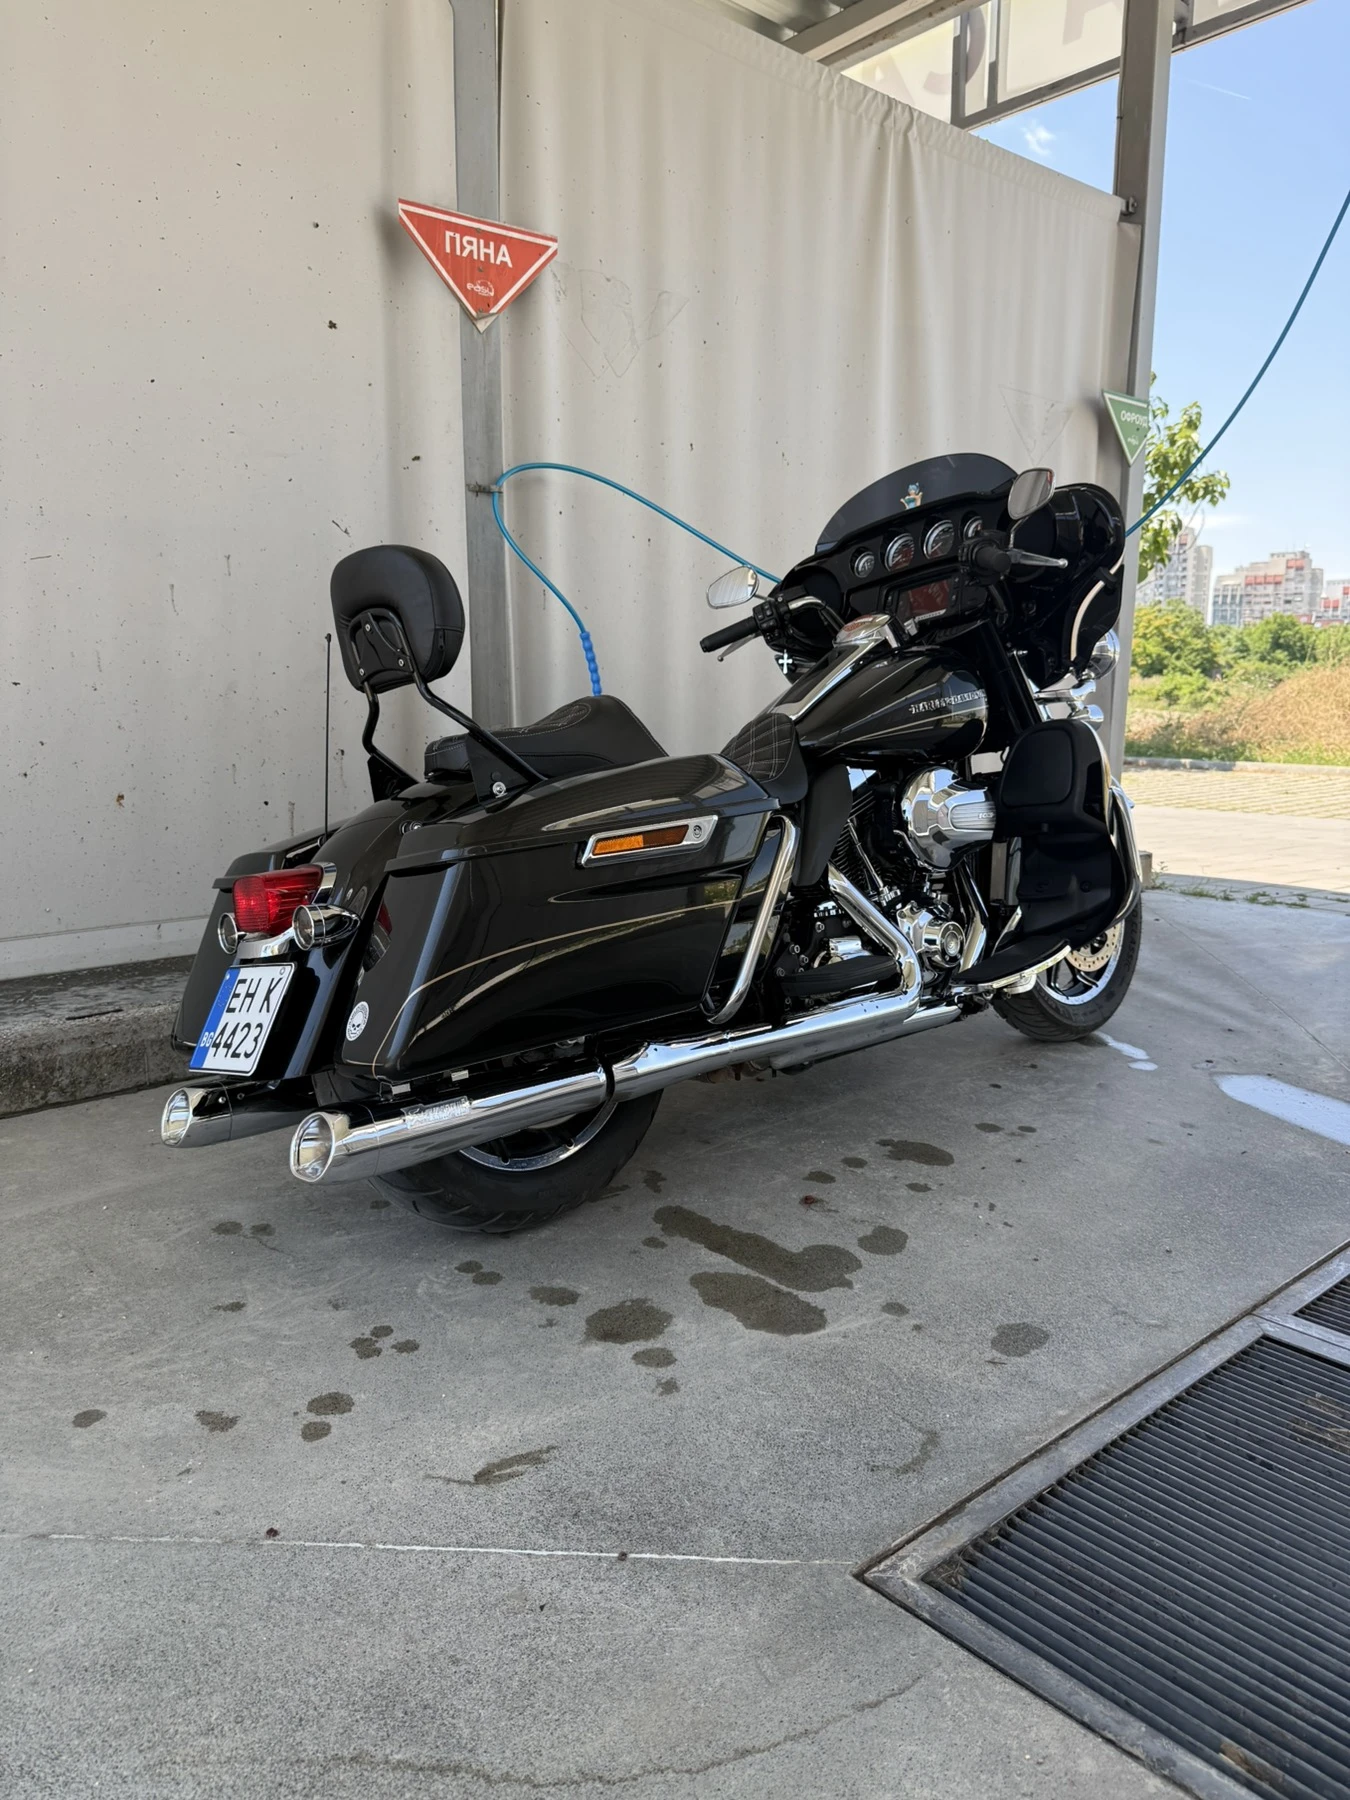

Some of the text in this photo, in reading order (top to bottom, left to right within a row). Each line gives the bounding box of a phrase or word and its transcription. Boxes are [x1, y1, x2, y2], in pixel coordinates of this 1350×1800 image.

[444, 230, 513, 268] ПЯНА
[226, 978, 283, 1013] EH K
[200, 1031, 215, 1048] BG
[211, 1021, 263, 1059] 4423
